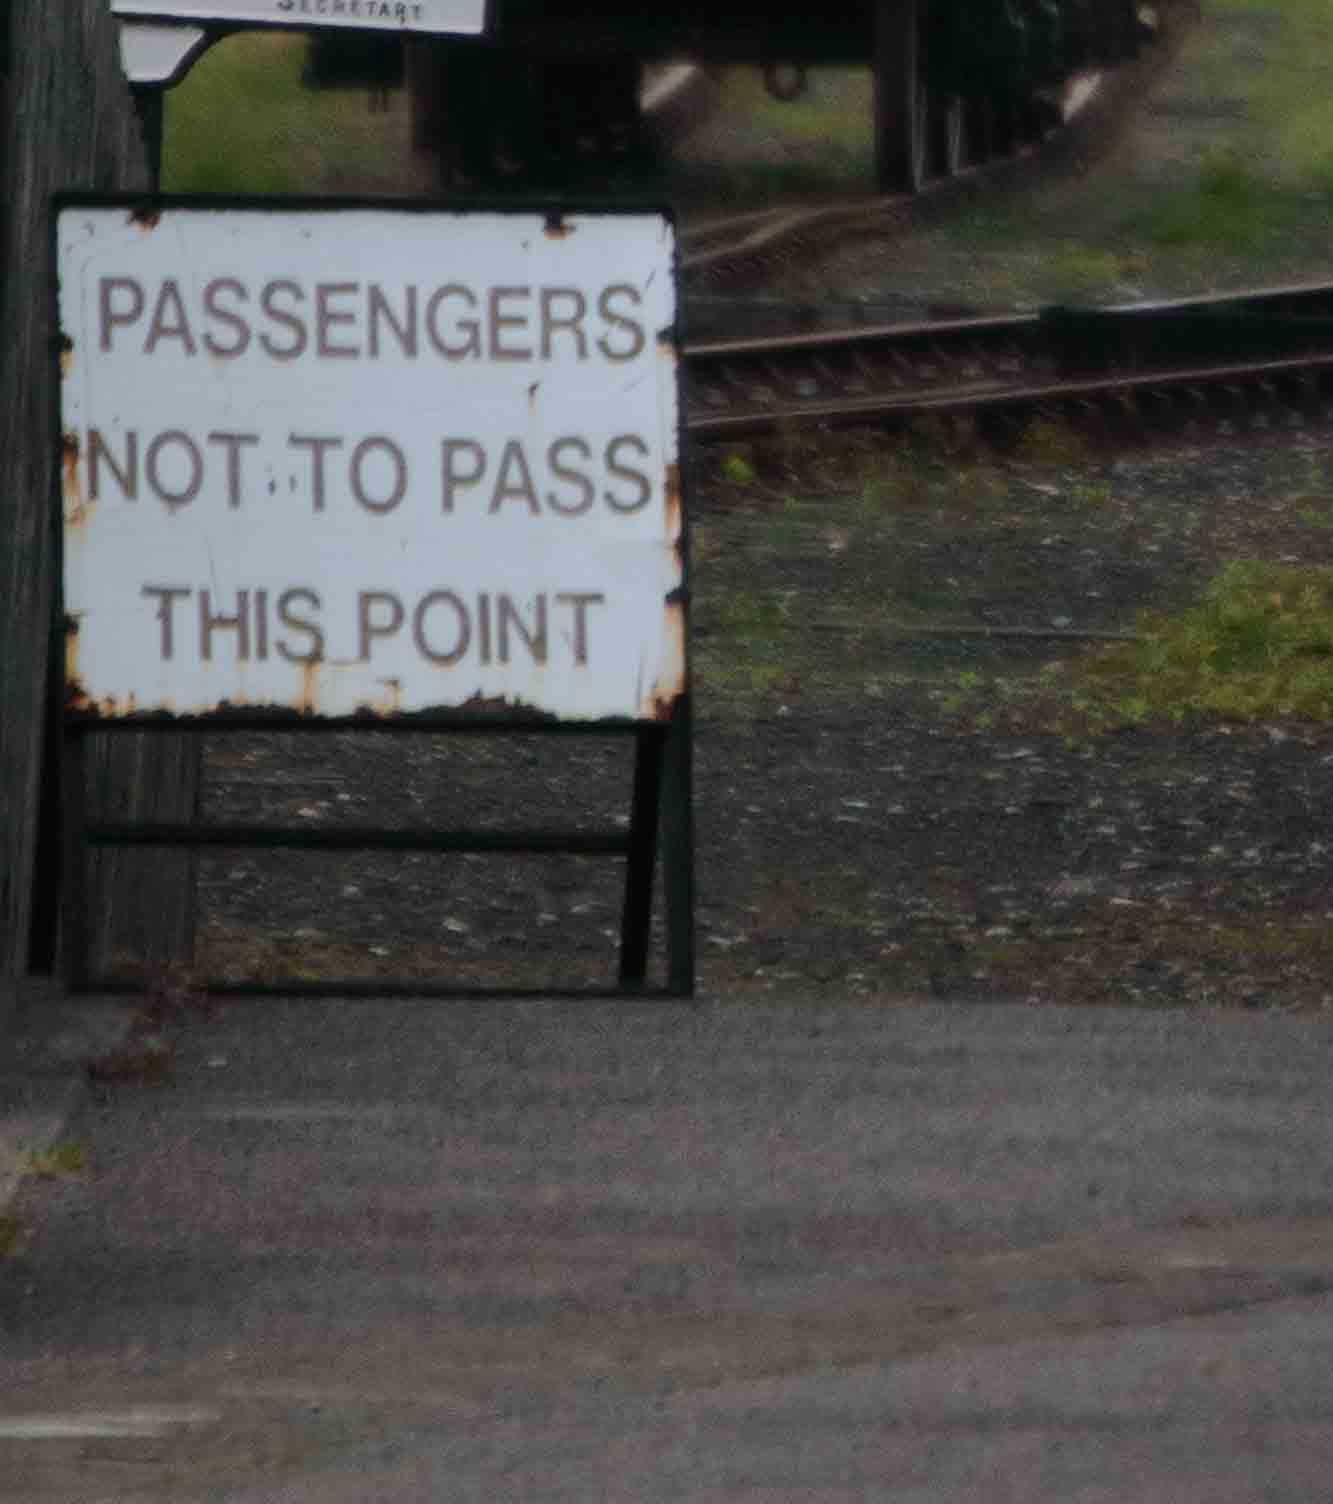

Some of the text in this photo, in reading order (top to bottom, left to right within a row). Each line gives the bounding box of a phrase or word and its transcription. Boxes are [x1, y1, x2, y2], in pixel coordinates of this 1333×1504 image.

[98, 276, 647, 363] PASSENGERS
[85, 428, 653, 516] NOT TO PASS
[140, 585, 605, 668] THIS POINT
